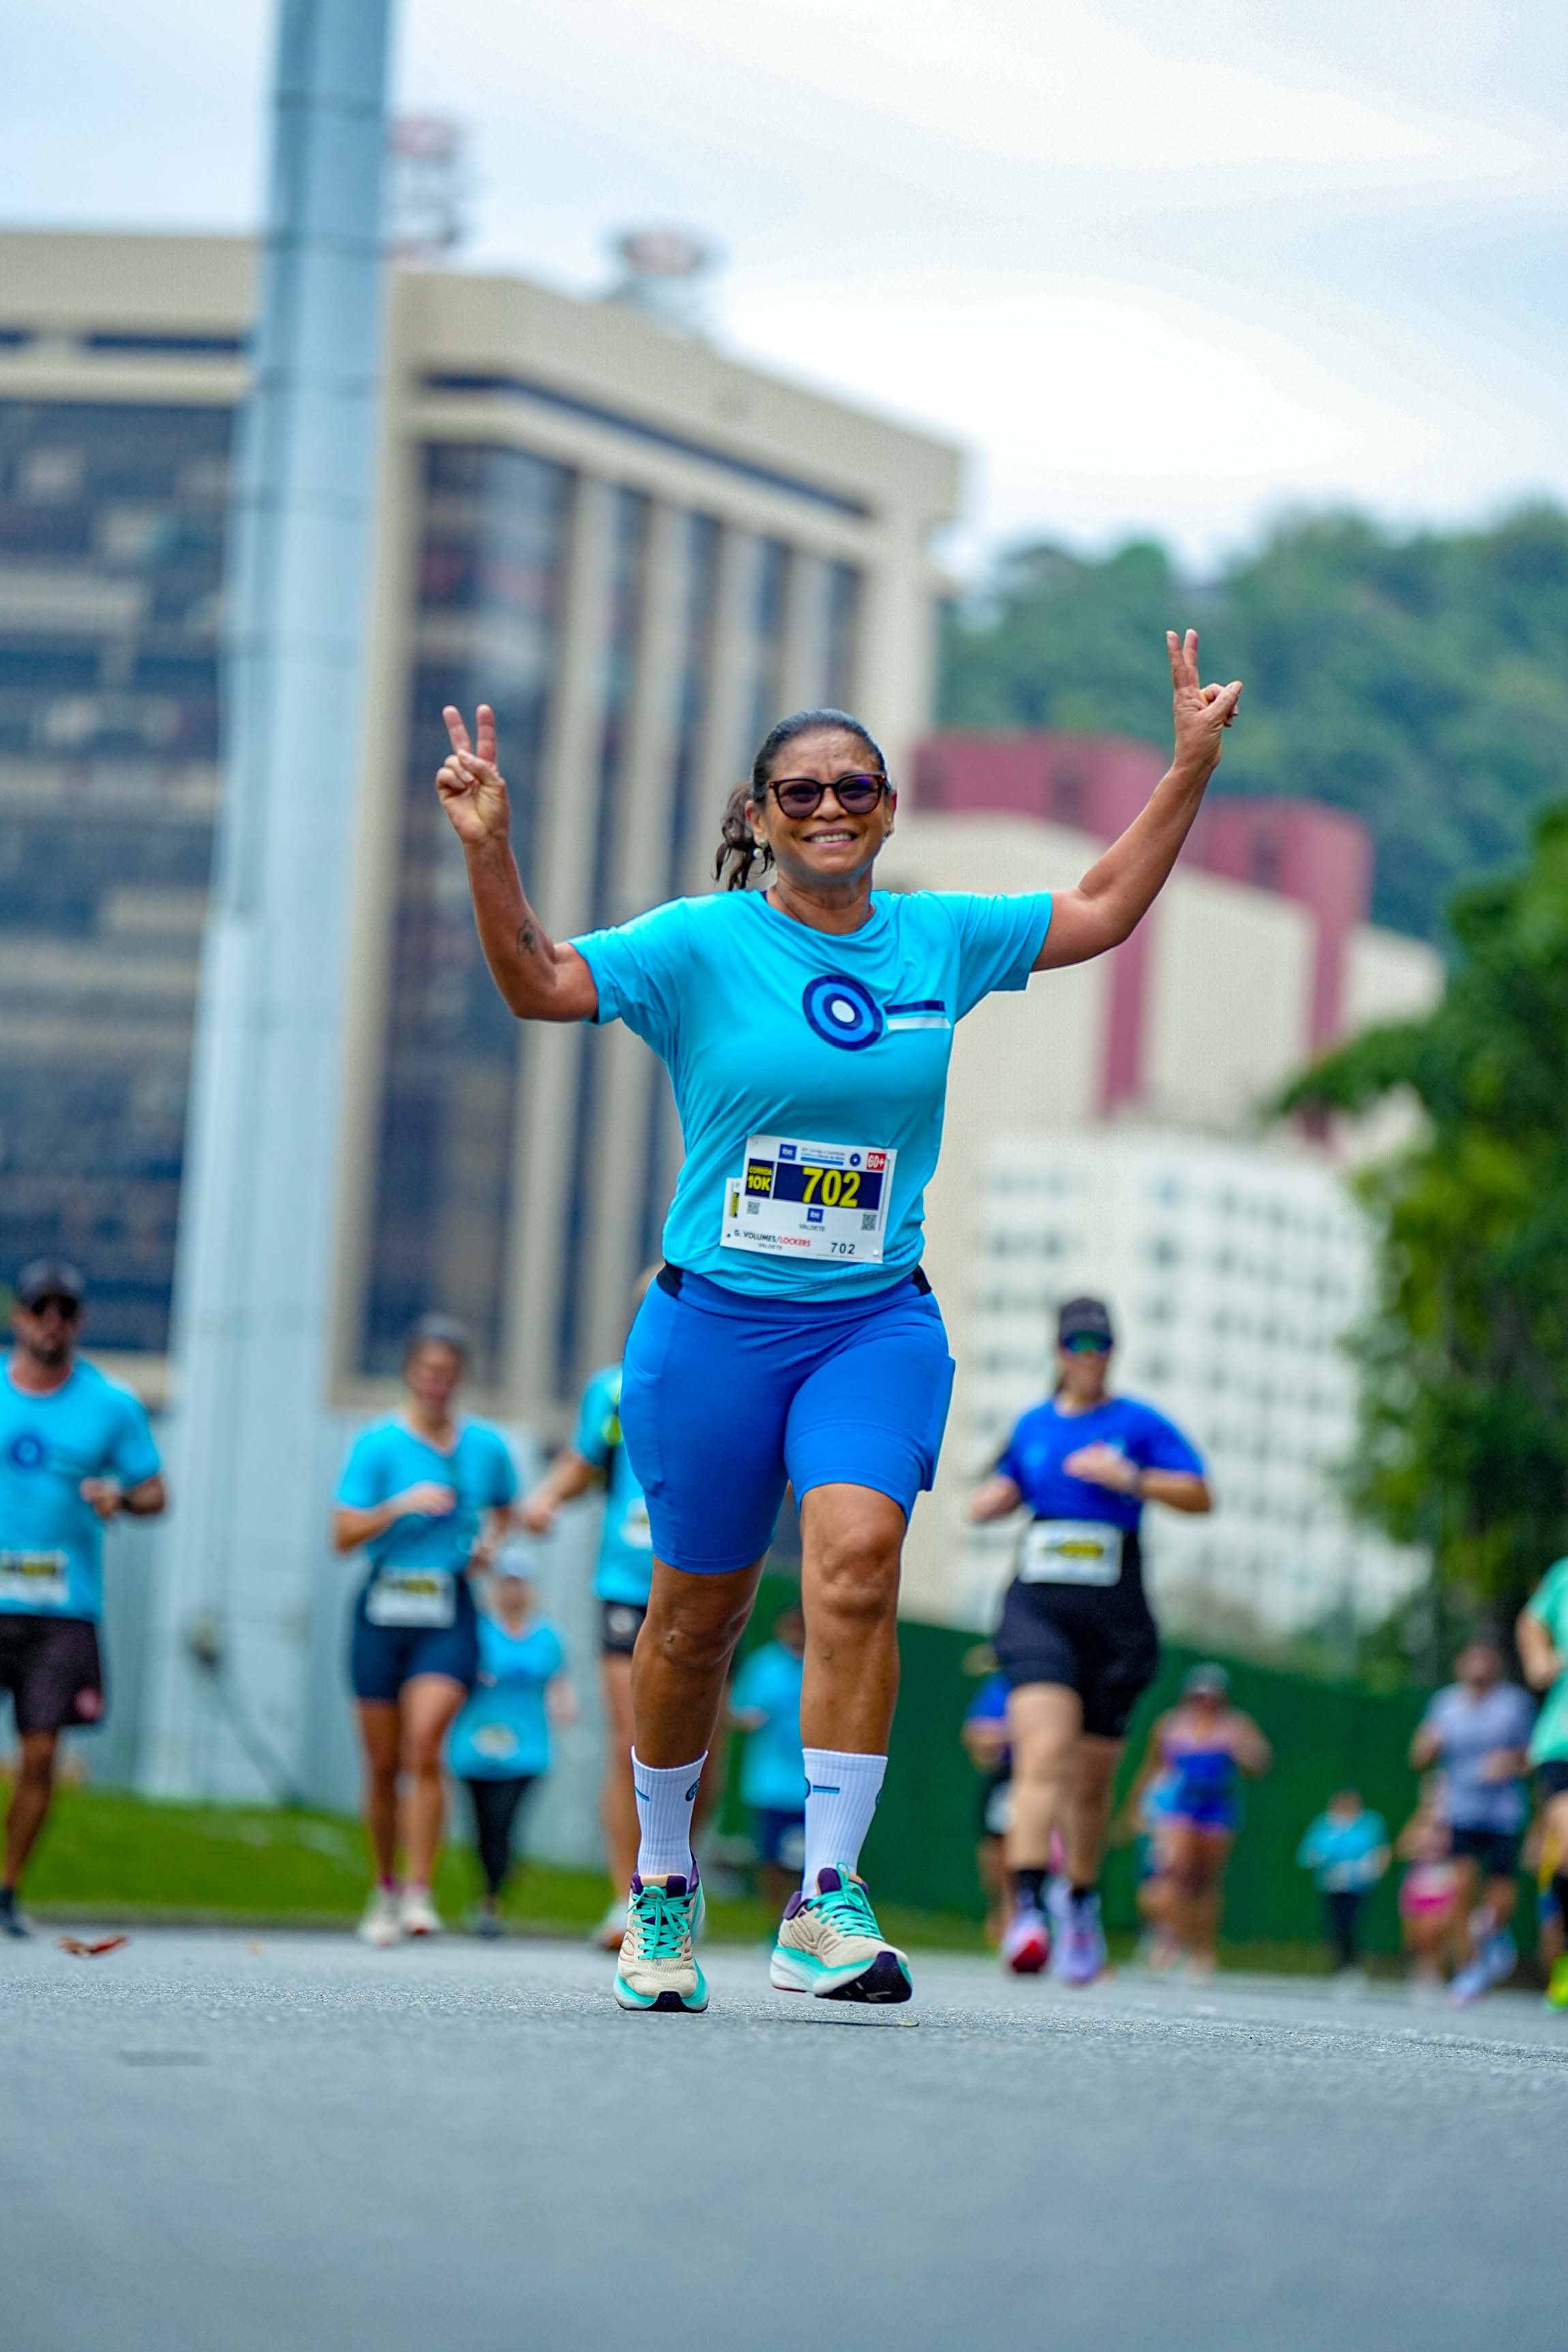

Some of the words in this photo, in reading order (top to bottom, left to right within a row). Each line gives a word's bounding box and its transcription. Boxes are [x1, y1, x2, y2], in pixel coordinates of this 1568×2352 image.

[867, 1154, 884, 1169] 60+
[748, 1175, 771, 1191] 10K
[802, 1166, 860, 1208] 702
[799, 1224, 826, 1232] VALDETE
[830, 1243, 856, 1254] 702
